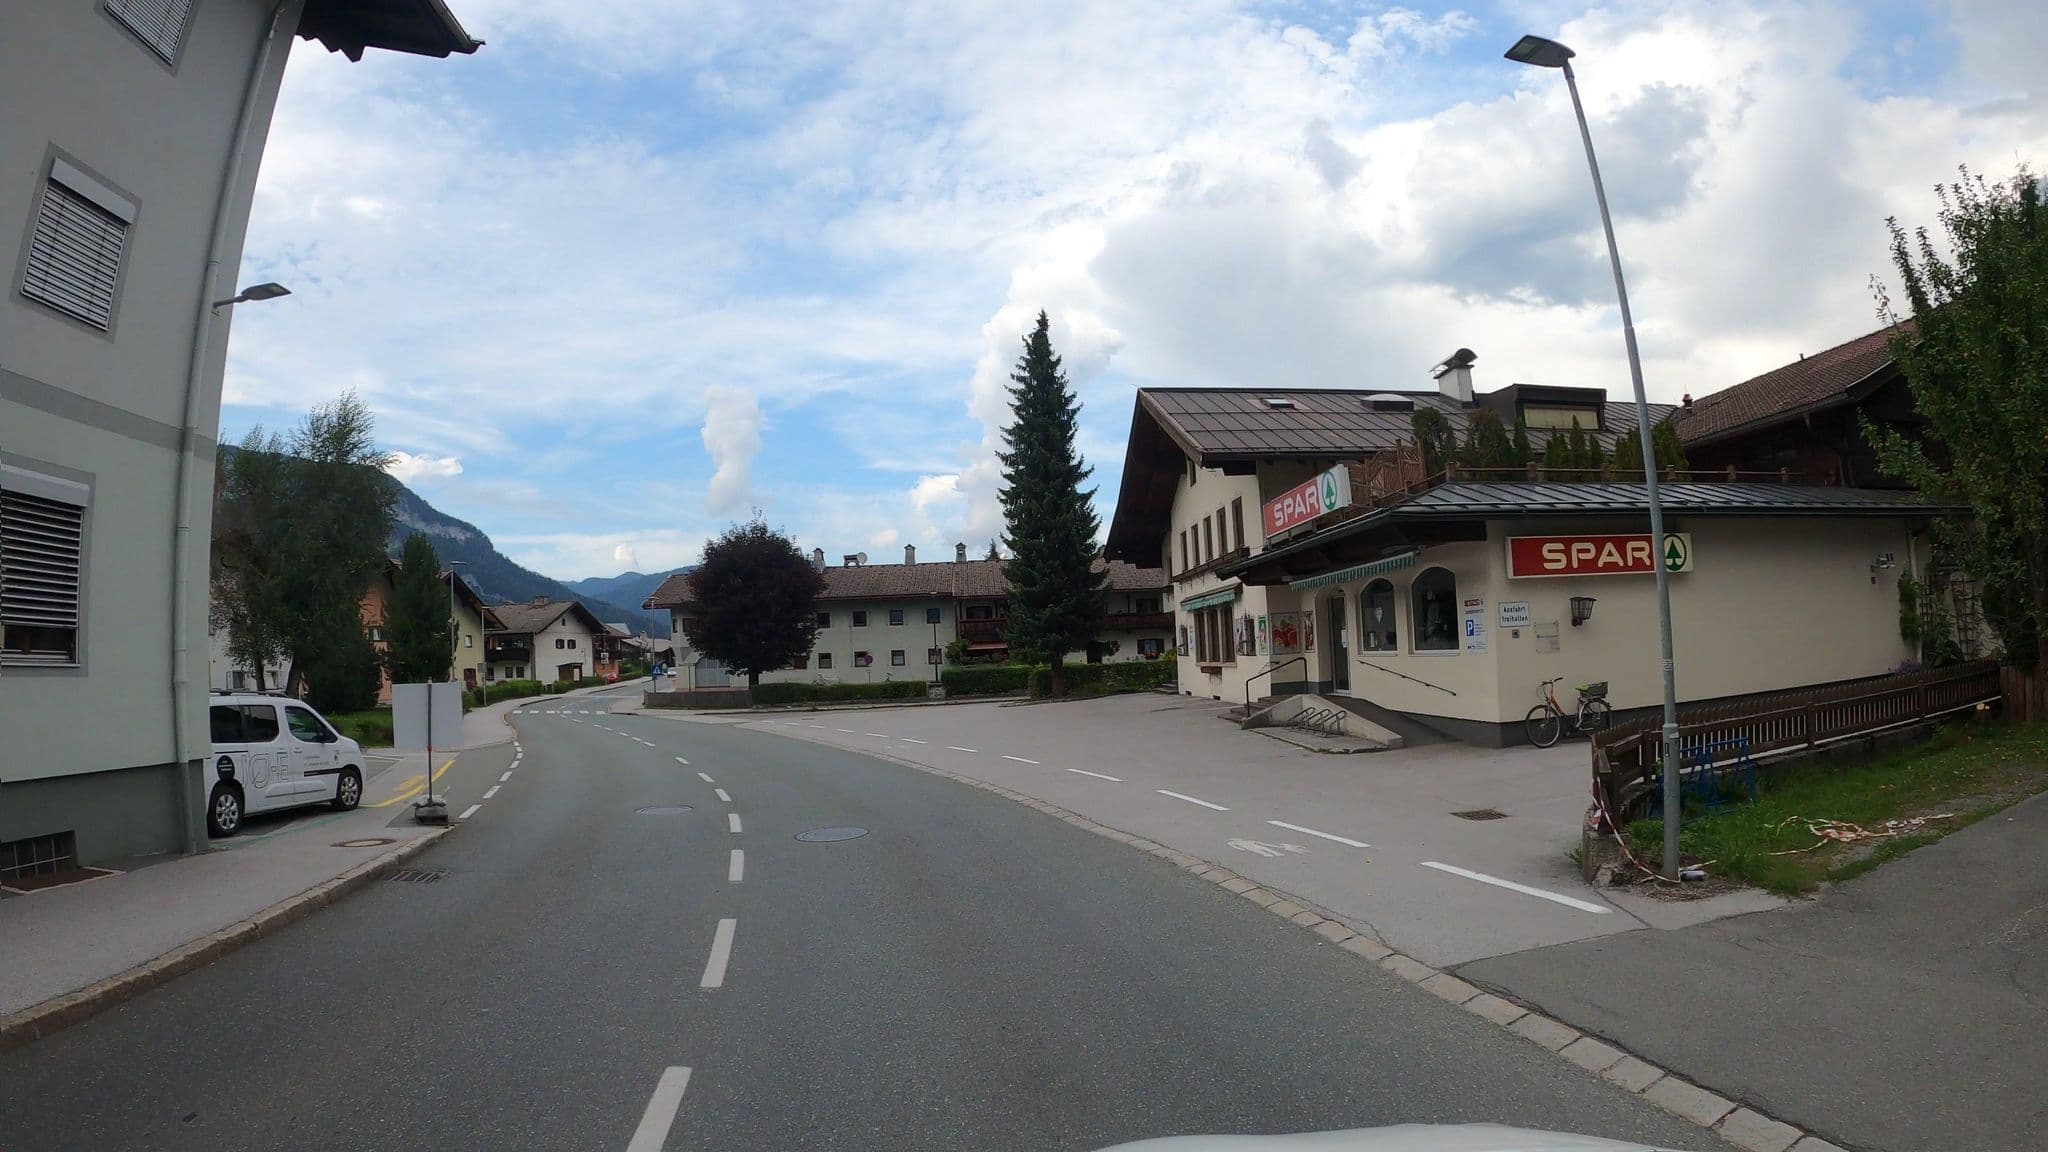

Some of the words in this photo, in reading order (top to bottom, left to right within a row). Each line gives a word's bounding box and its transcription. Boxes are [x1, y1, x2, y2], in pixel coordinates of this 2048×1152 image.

[1273, 485, 1319, 527] SPAR
[1541, 540, 1651, 570] SPAR
[1503, 605, 1526, 613] Ausfahrt
